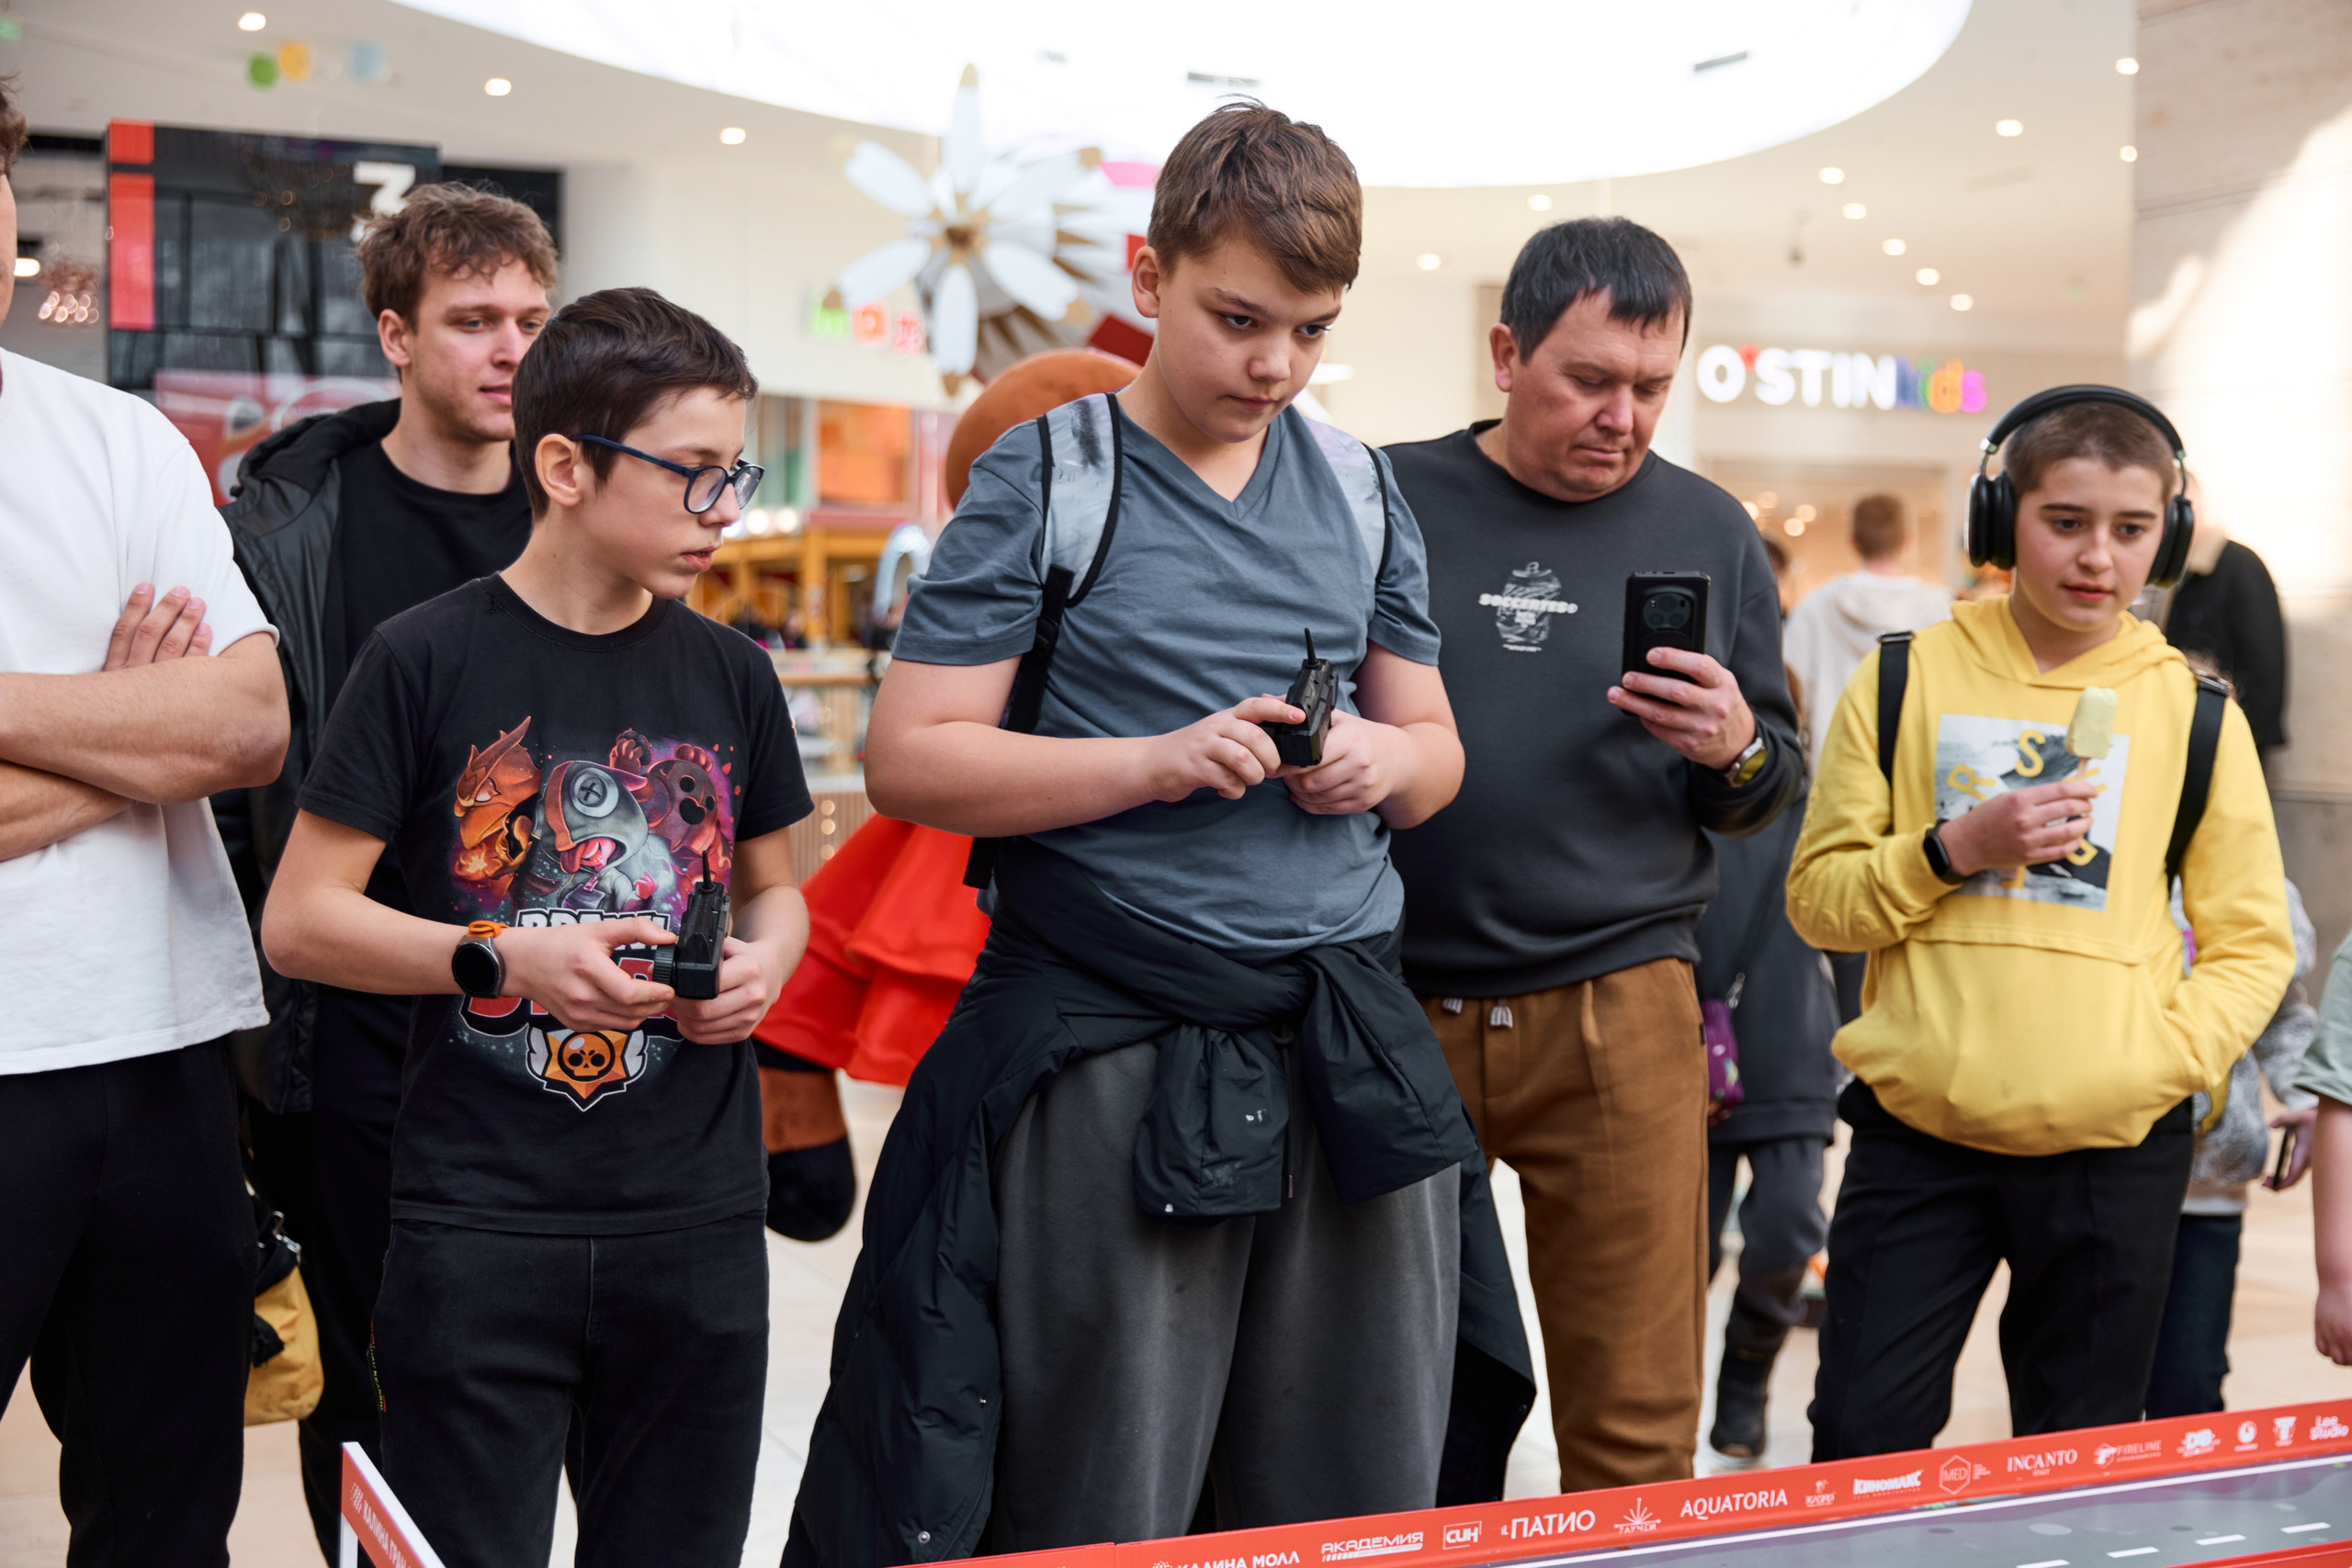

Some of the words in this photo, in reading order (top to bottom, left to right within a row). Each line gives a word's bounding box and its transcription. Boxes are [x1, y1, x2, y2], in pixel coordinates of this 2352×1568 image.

[2007, 1449, 2078, 1472] INCANTO
[1852, 1470, 1923, 1495] КИНОМАКС
[1942, 1467, 1968, 1483] MED
[1679, 1488, 1789, 1520] AQUATORIA
[1510, 1509, 1597, 1540] ПАТИО
[1321, 1531, 1424, 1554] АКАДЕМИЯ
[1252, 1551, 1301, 1568] МОЛЛ
